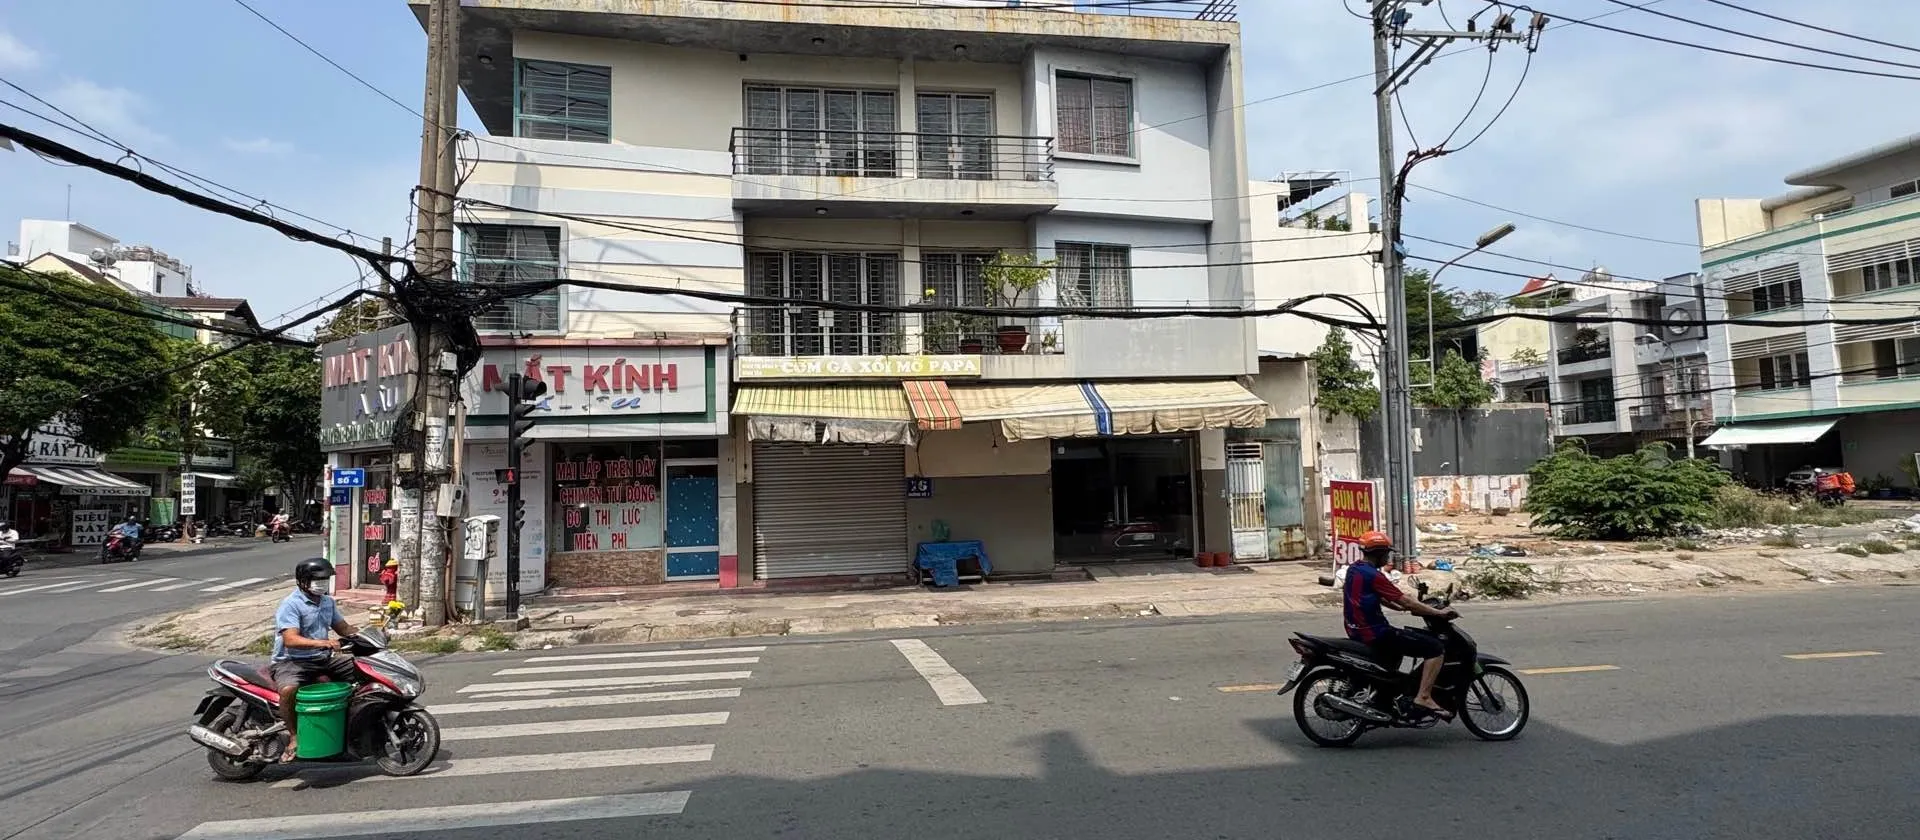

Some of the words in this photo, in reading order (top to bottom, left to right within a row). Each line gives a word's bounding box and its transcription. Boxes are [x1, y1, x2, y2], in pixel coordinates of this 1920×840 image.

[583, 358, 678, 391] KÍNH
[929, 359, 977, 373] PAPA
[1333, 485, 1355, 512] BÚN
[1356, 486, 1372, 512] CÁ
